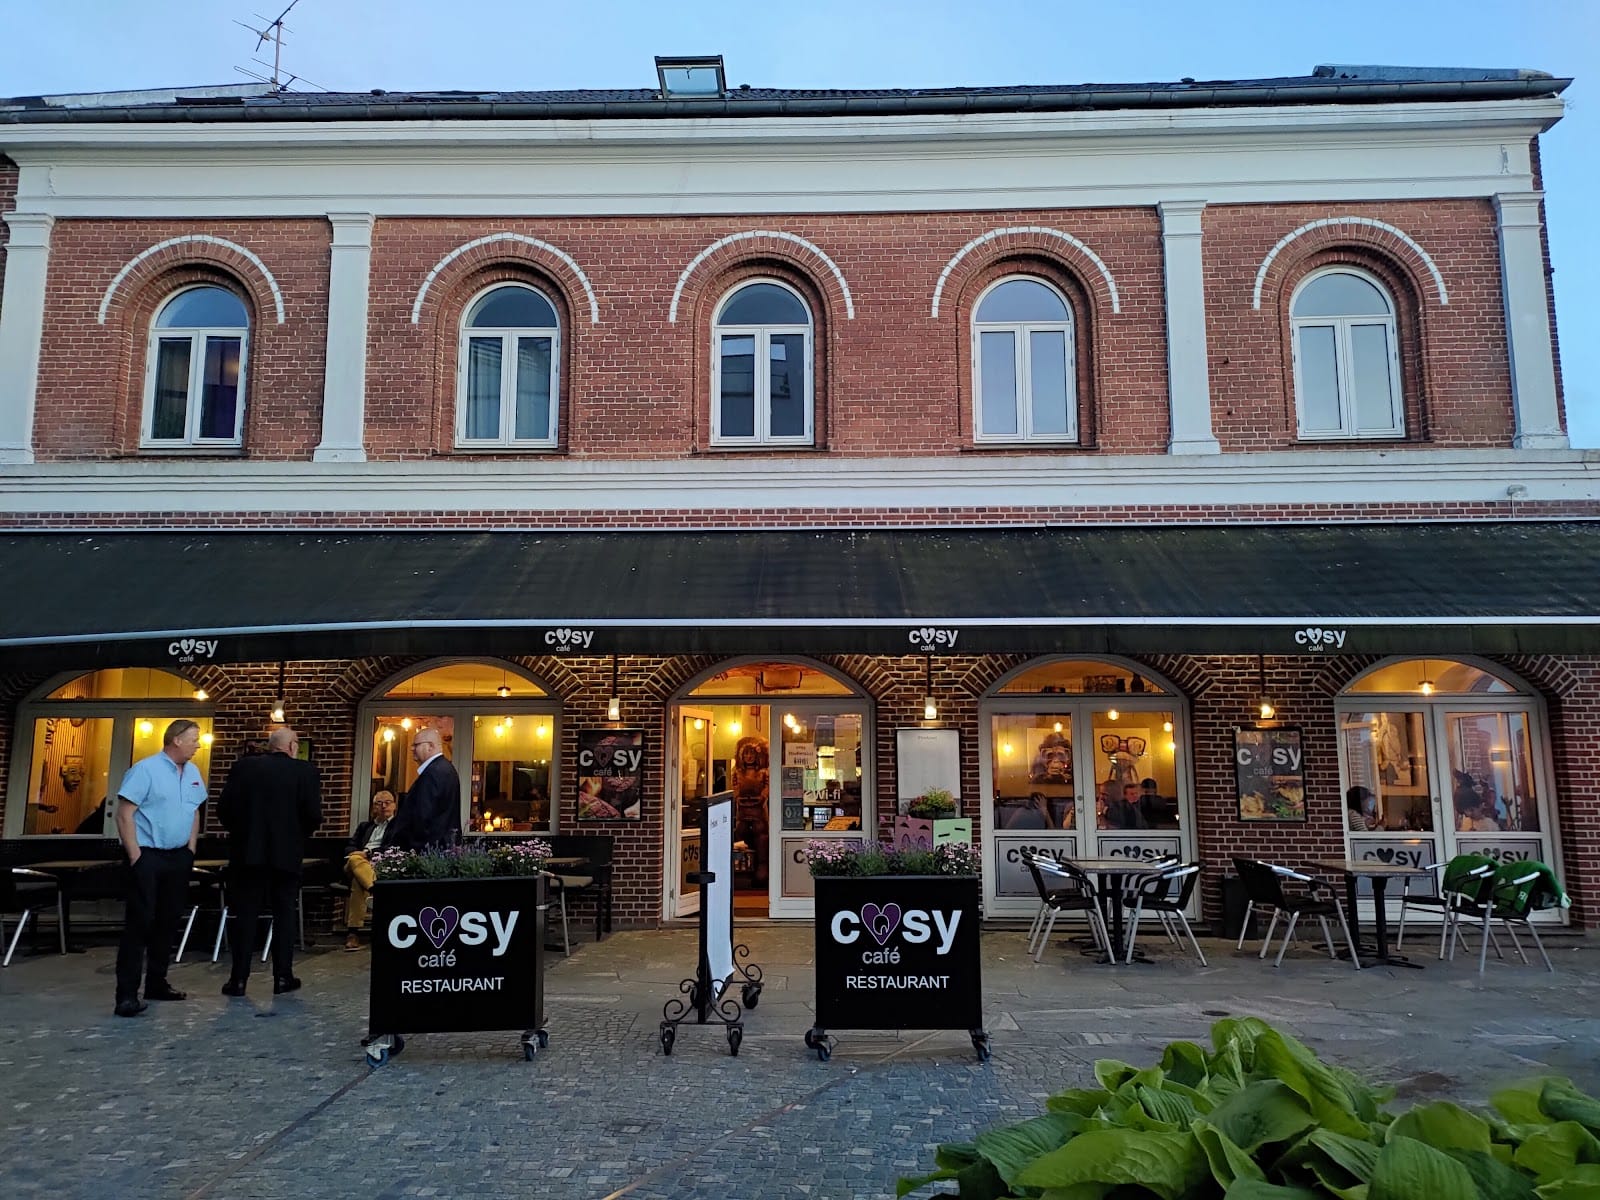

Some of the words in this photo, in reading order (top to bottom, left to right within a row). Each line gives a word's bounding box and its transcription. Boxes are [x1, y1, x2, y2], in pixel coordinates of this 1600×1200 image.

[593, 767, 612, 776] café
[418, 949, 457, 968] café
[862, 946, 901, 964] café
[401, 977, 504, 994] RESTAURANT
[846, 976, 950, 989] RESTAURANT
